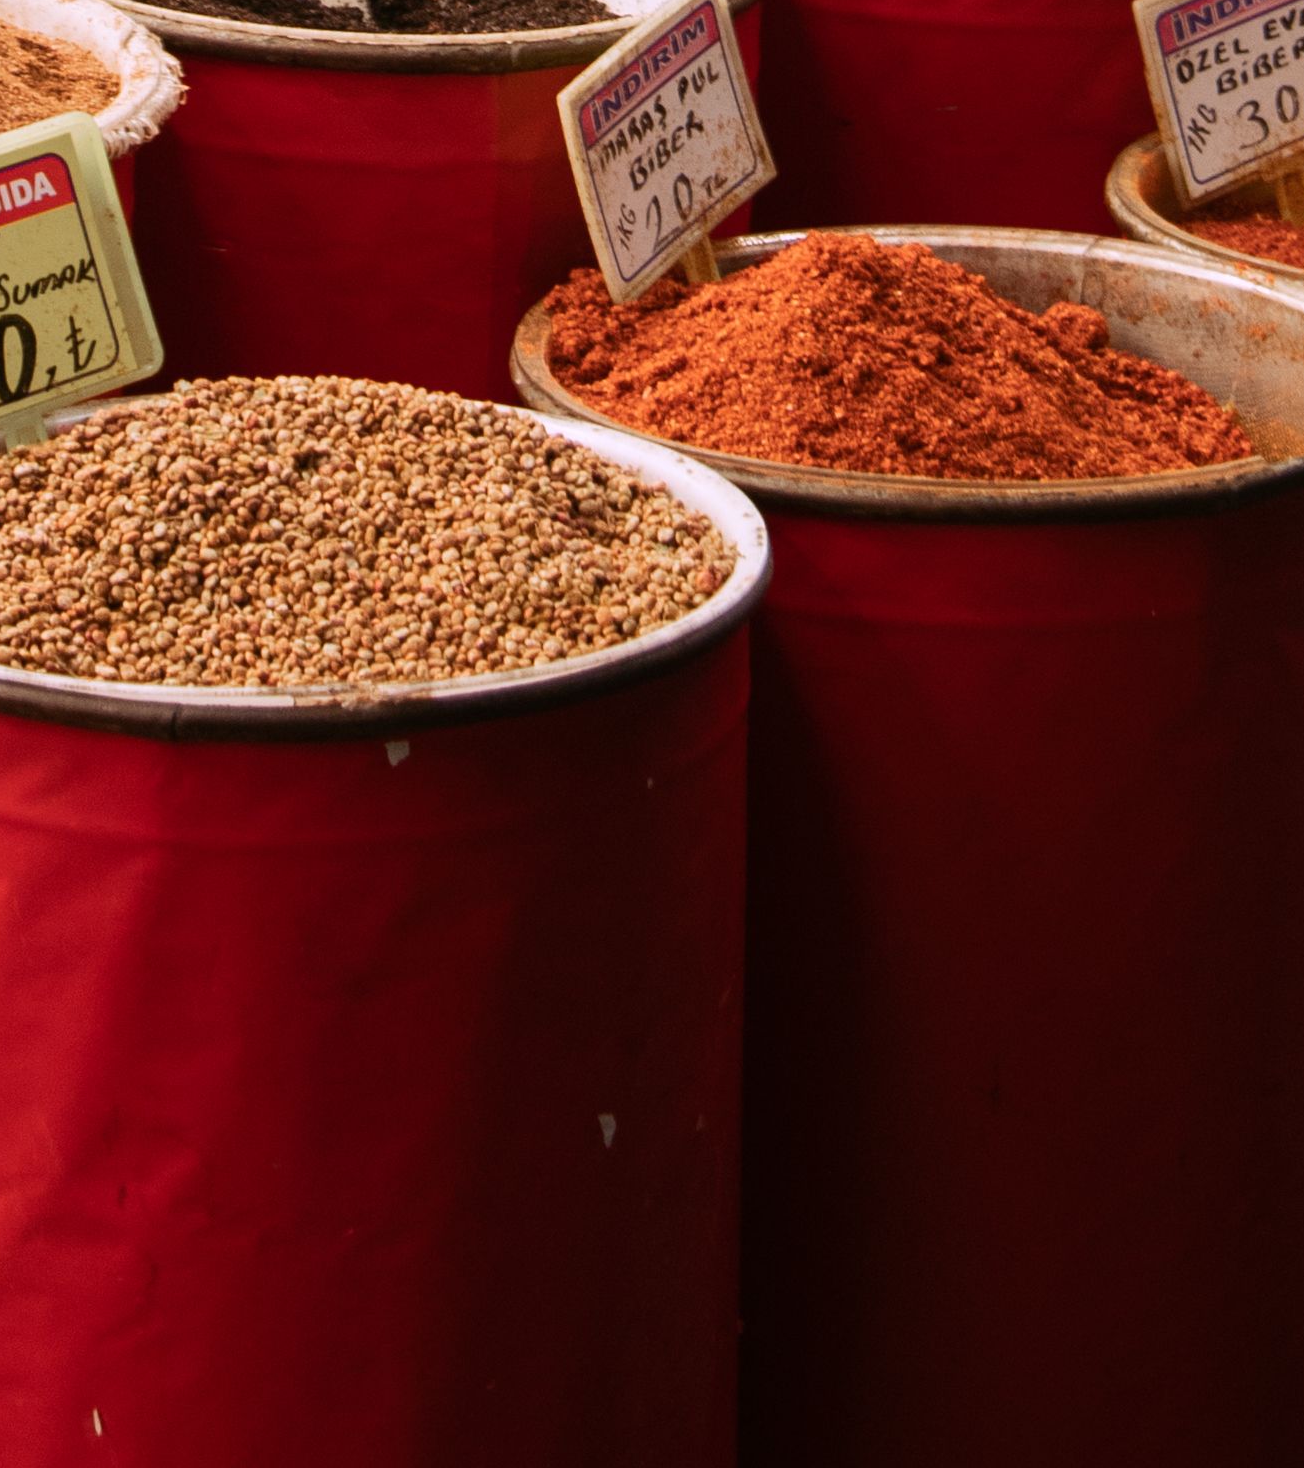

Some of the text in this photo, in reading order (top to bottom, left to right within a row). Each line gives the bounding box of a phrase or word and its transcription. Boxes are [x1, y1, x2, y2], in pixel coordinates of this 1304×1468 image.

[589, 13, 707, 134] İNDİRİM
[1174, 37, 1250, 86] ÖZEL
[597, 60, 722, 174] MARAŞ PUL
[1186, 102, 1218, 155] 1KG
[1235, 83, 1302, 152] 30
[617, 202, 638, 252] 1KG
[644, 171, 694, 257] 20
